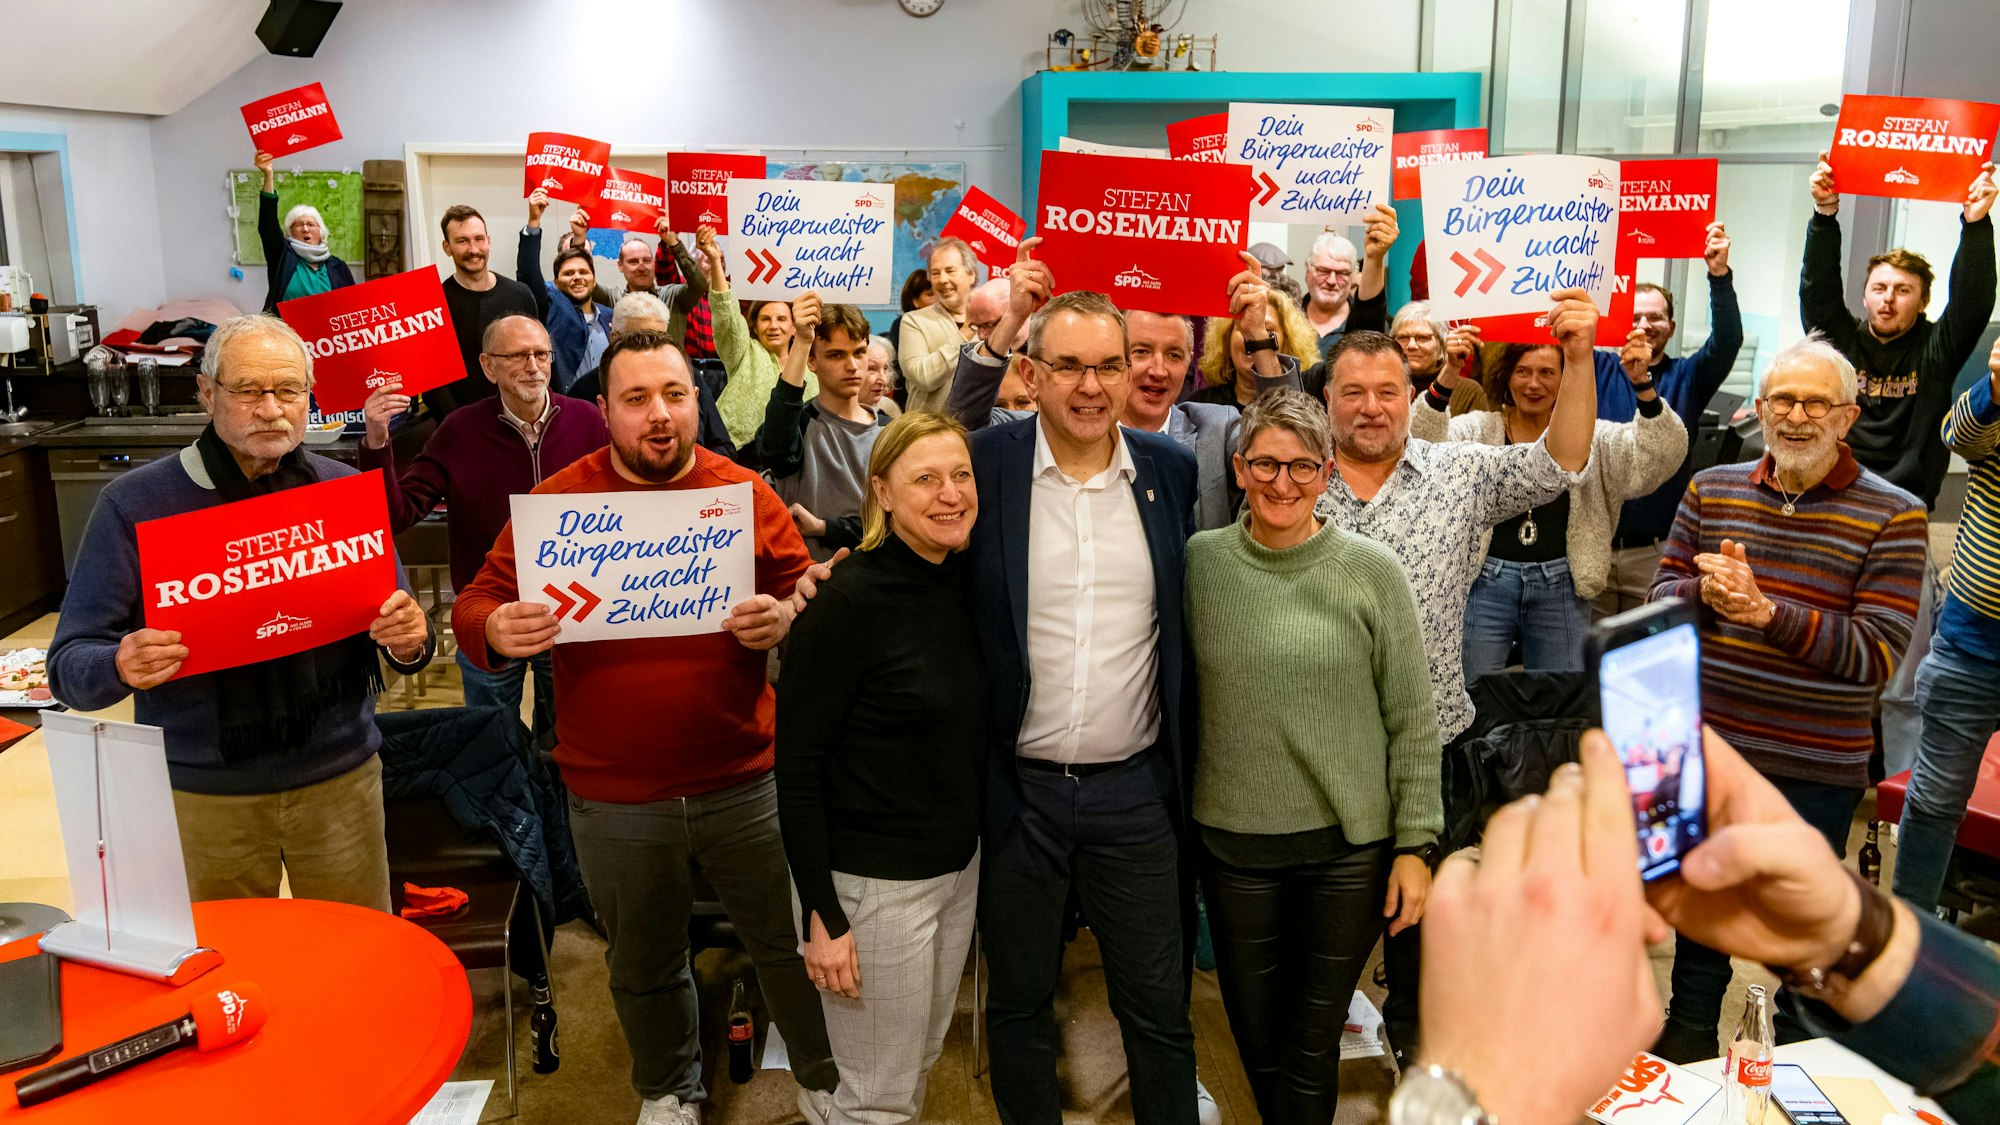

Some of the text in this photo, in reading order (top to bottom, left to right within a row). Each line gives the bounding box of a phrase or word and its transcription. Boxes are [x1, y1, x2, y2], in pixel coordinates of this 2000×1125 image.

[250, 102, 328, 135] ROSEMANN
[266, 100, 302, 117] STEFAN
[1257, 114, 1304, 136] Dein
[1356, 124, 1372, 132] SPD
[1883, 116, 1949, 134] STEFAN
[543, 144, 580, 158] STEFAN
[1192, 133, 1228, 150] STEFA
[1240, 137, 1384, 170] Bürgermeister
[1420, 142, 1459, 154] STEFAN
[1838, 128, 1988, 156] ROSEMANN
[526, 154, 604, 176] ROSEMANN
[1396, 151, 1484, 169] ROSEMANN
[692, 169, 733, 181] STEFAN
[1295, 161, 1364, 185] macht
[1462, 168, 1525, 202] Dein
[1588, 178, 1604, 188] SPD
[1884, 173, 1904, 184] SPD
[601, 188, 663, 207] SEMANN
[606, 180, 642, 192] STEFAN
[670, 180, 728, 196] ROSEMA
[1620, 180, 1672, 194] TEFAN
[756, 190, 800, 212] Dein
[855, 200, 872, 208] SPD
[1104, 188, 1192, 212] STEFAN
[1280, 188, 1372, 214] Zukunft!
[1620, 194, 1710, 212] EMANN
[741, 212, 885, 247] Bürgermeister
[958, 204, 1019, 248] ROSEMANN
[982, 208, 1010, 231] STEFAN
[1044, 205, 1242, 244] ROSEMANN
[1443, 194, 1614, 243] Bürgermeister
[795, 236, 864, 262] macht
[1525, 224, 1600, 258] macht
[784, 264, 874, 292] Zukunft!
[1114, 274, 1142, 288] SPD
[1510, 260, 1604, 295] Zukunft!
[329, 302, 398, 332] STEFAN
[302, 306, 444, 360] ROSEMANN
[366, 376, 386, 388] SPD
[556, 504, 623, 537] Dein
[700, 508, 724, 518] SPD
[226, 520, 325, 562] STEFAN
[535, 525, 742, 578] Bürgermeister
[155, 529, 384, 608] ROSEMANN
[620, 554, 718, 592] macht
[606, 586, 732, 625] Zukunft!
[256, 622, 288, 639] SPD
[217, 990, 236, 1015] SPD
[1616, 1054, 1666, 1092] SPD
